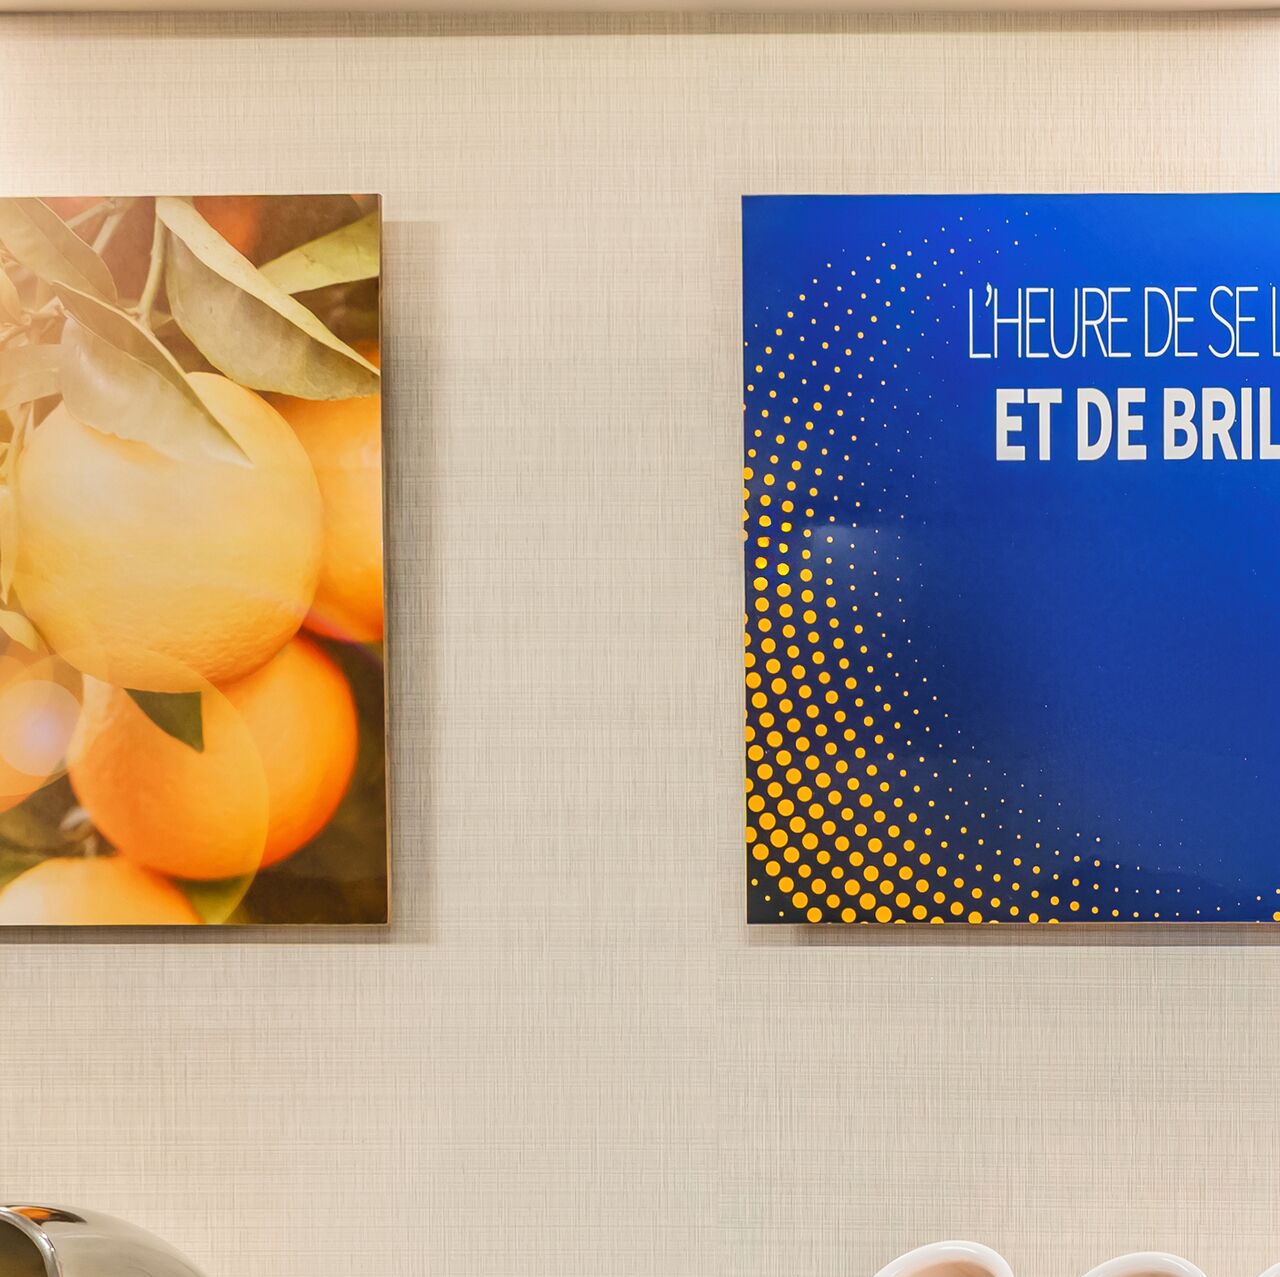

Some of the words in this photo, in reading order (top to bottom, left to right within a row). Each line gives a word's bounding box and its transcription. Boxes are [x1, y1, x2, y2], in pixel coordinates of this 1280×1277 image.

[1144, 286, 1198, 358] DE
[1208, 285, 1260, 358] SE
[996, 388, 1063, 461] ET
[1077, 387, 1147, 461] DE
